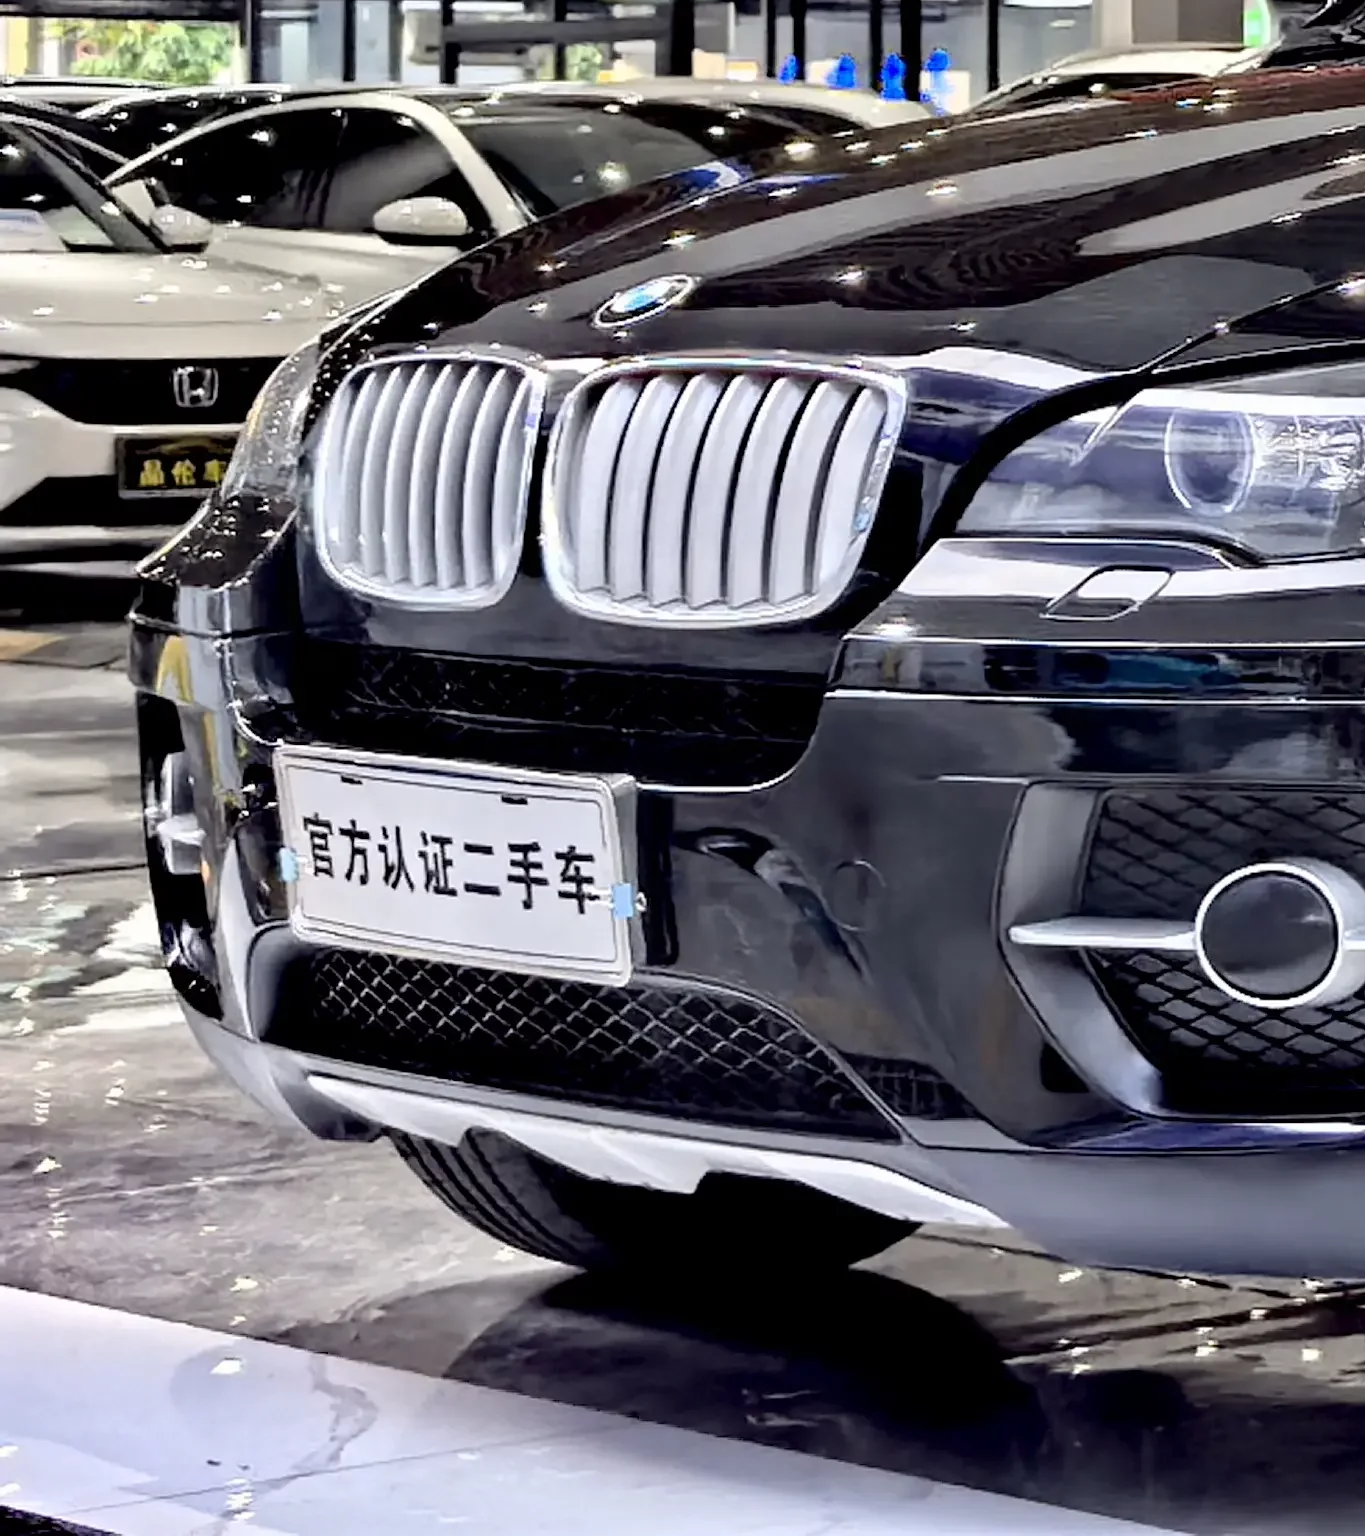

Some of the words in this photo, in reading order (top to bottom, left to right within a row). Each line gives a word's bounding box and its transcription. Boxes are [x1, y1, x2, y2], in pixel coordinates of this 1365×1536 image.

[303, 811, 597, 915] 官方认证二手车
